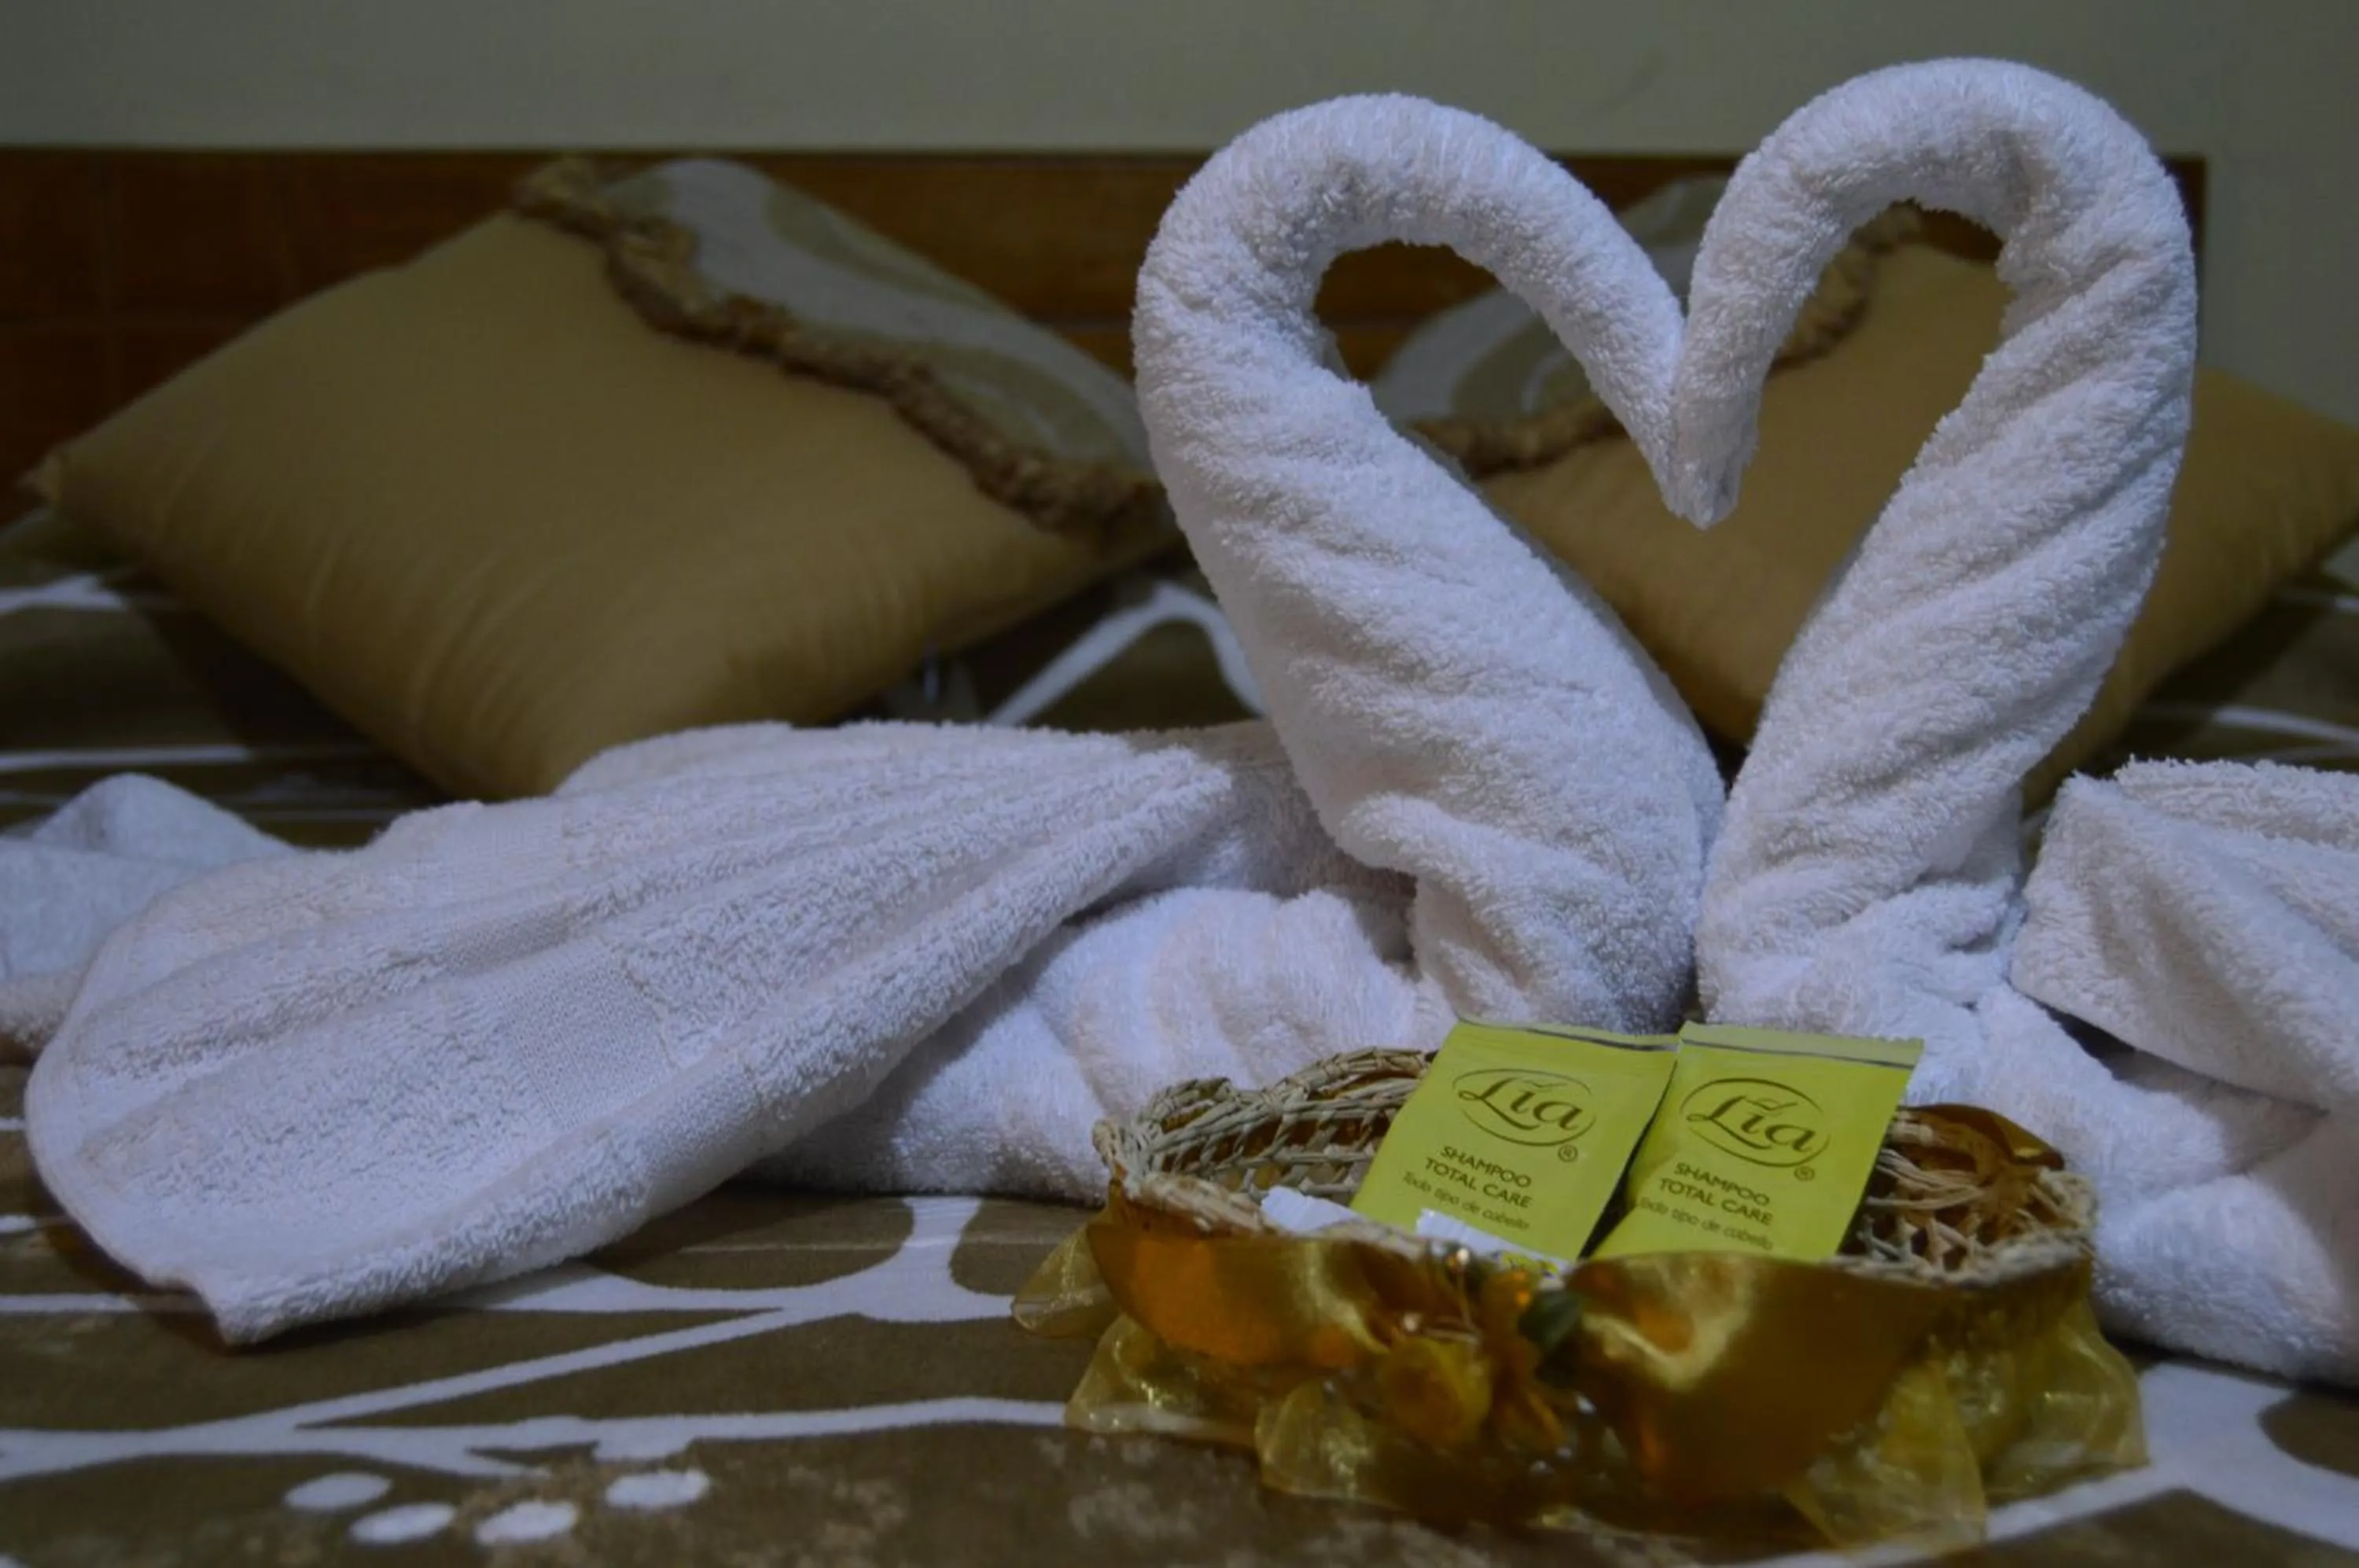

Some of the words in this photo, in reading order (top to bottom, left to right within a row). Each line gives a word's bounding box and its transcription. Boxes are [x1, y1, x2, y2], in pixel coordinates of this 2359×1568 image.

[1458, 1077, 1583, 1131] Lia
[1686, 1095, 1816, 1153] Lia
[1425, 1157, 1477, 1191] TOTAL
[1482, 1183, 1533, 1208] CARE
[1441, 1146, 1532, 1187] SHAMPOO
[1674, 1162, 1770, 1205] SHAMPOO
[1462, 1202, 1481, 1213] de
[1660, 1178, 1715, 1206] TOTAL
[1721, 1199, 1773, 1226] CARE
[1702, 1218, 1720, 1231] de
